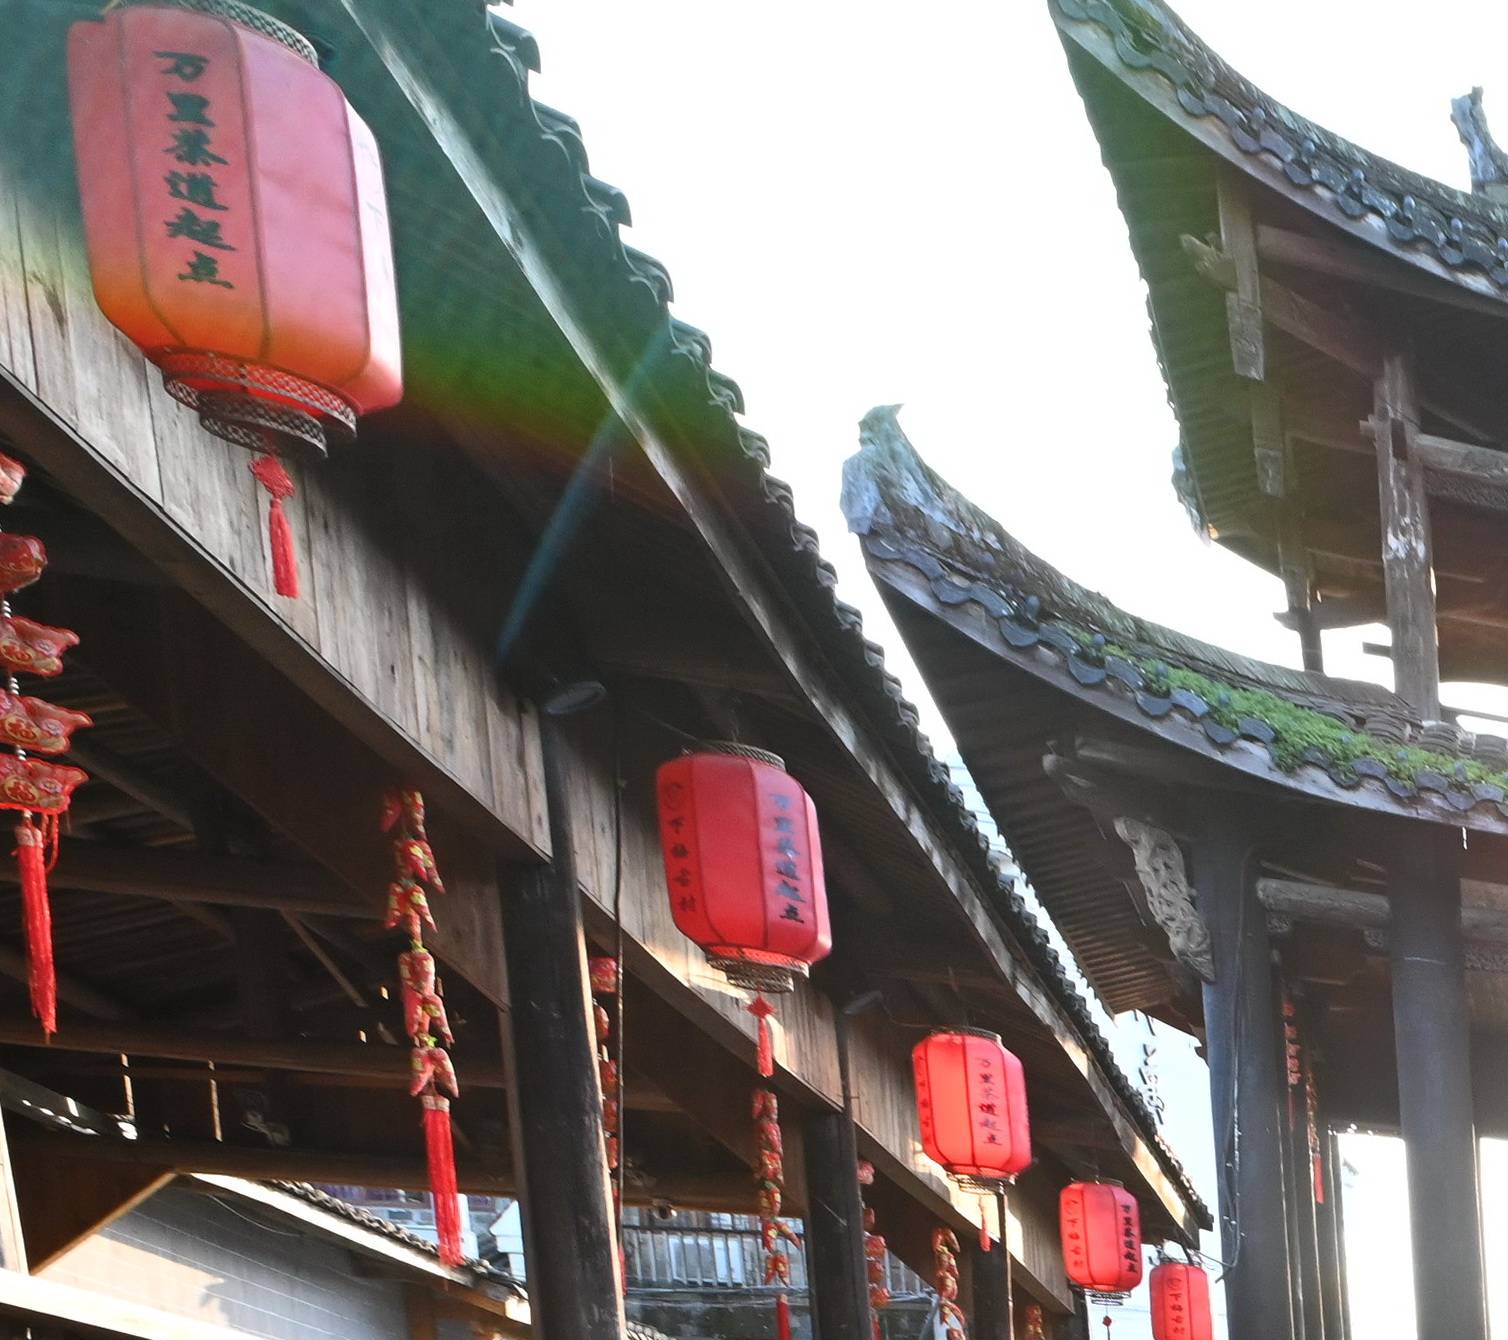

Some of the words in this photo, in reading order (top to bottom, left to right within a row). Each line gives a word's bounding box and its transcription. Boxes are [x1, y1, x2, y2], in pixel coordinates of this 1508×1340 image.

[153, 51, 237, 289] 万里茶道起点
